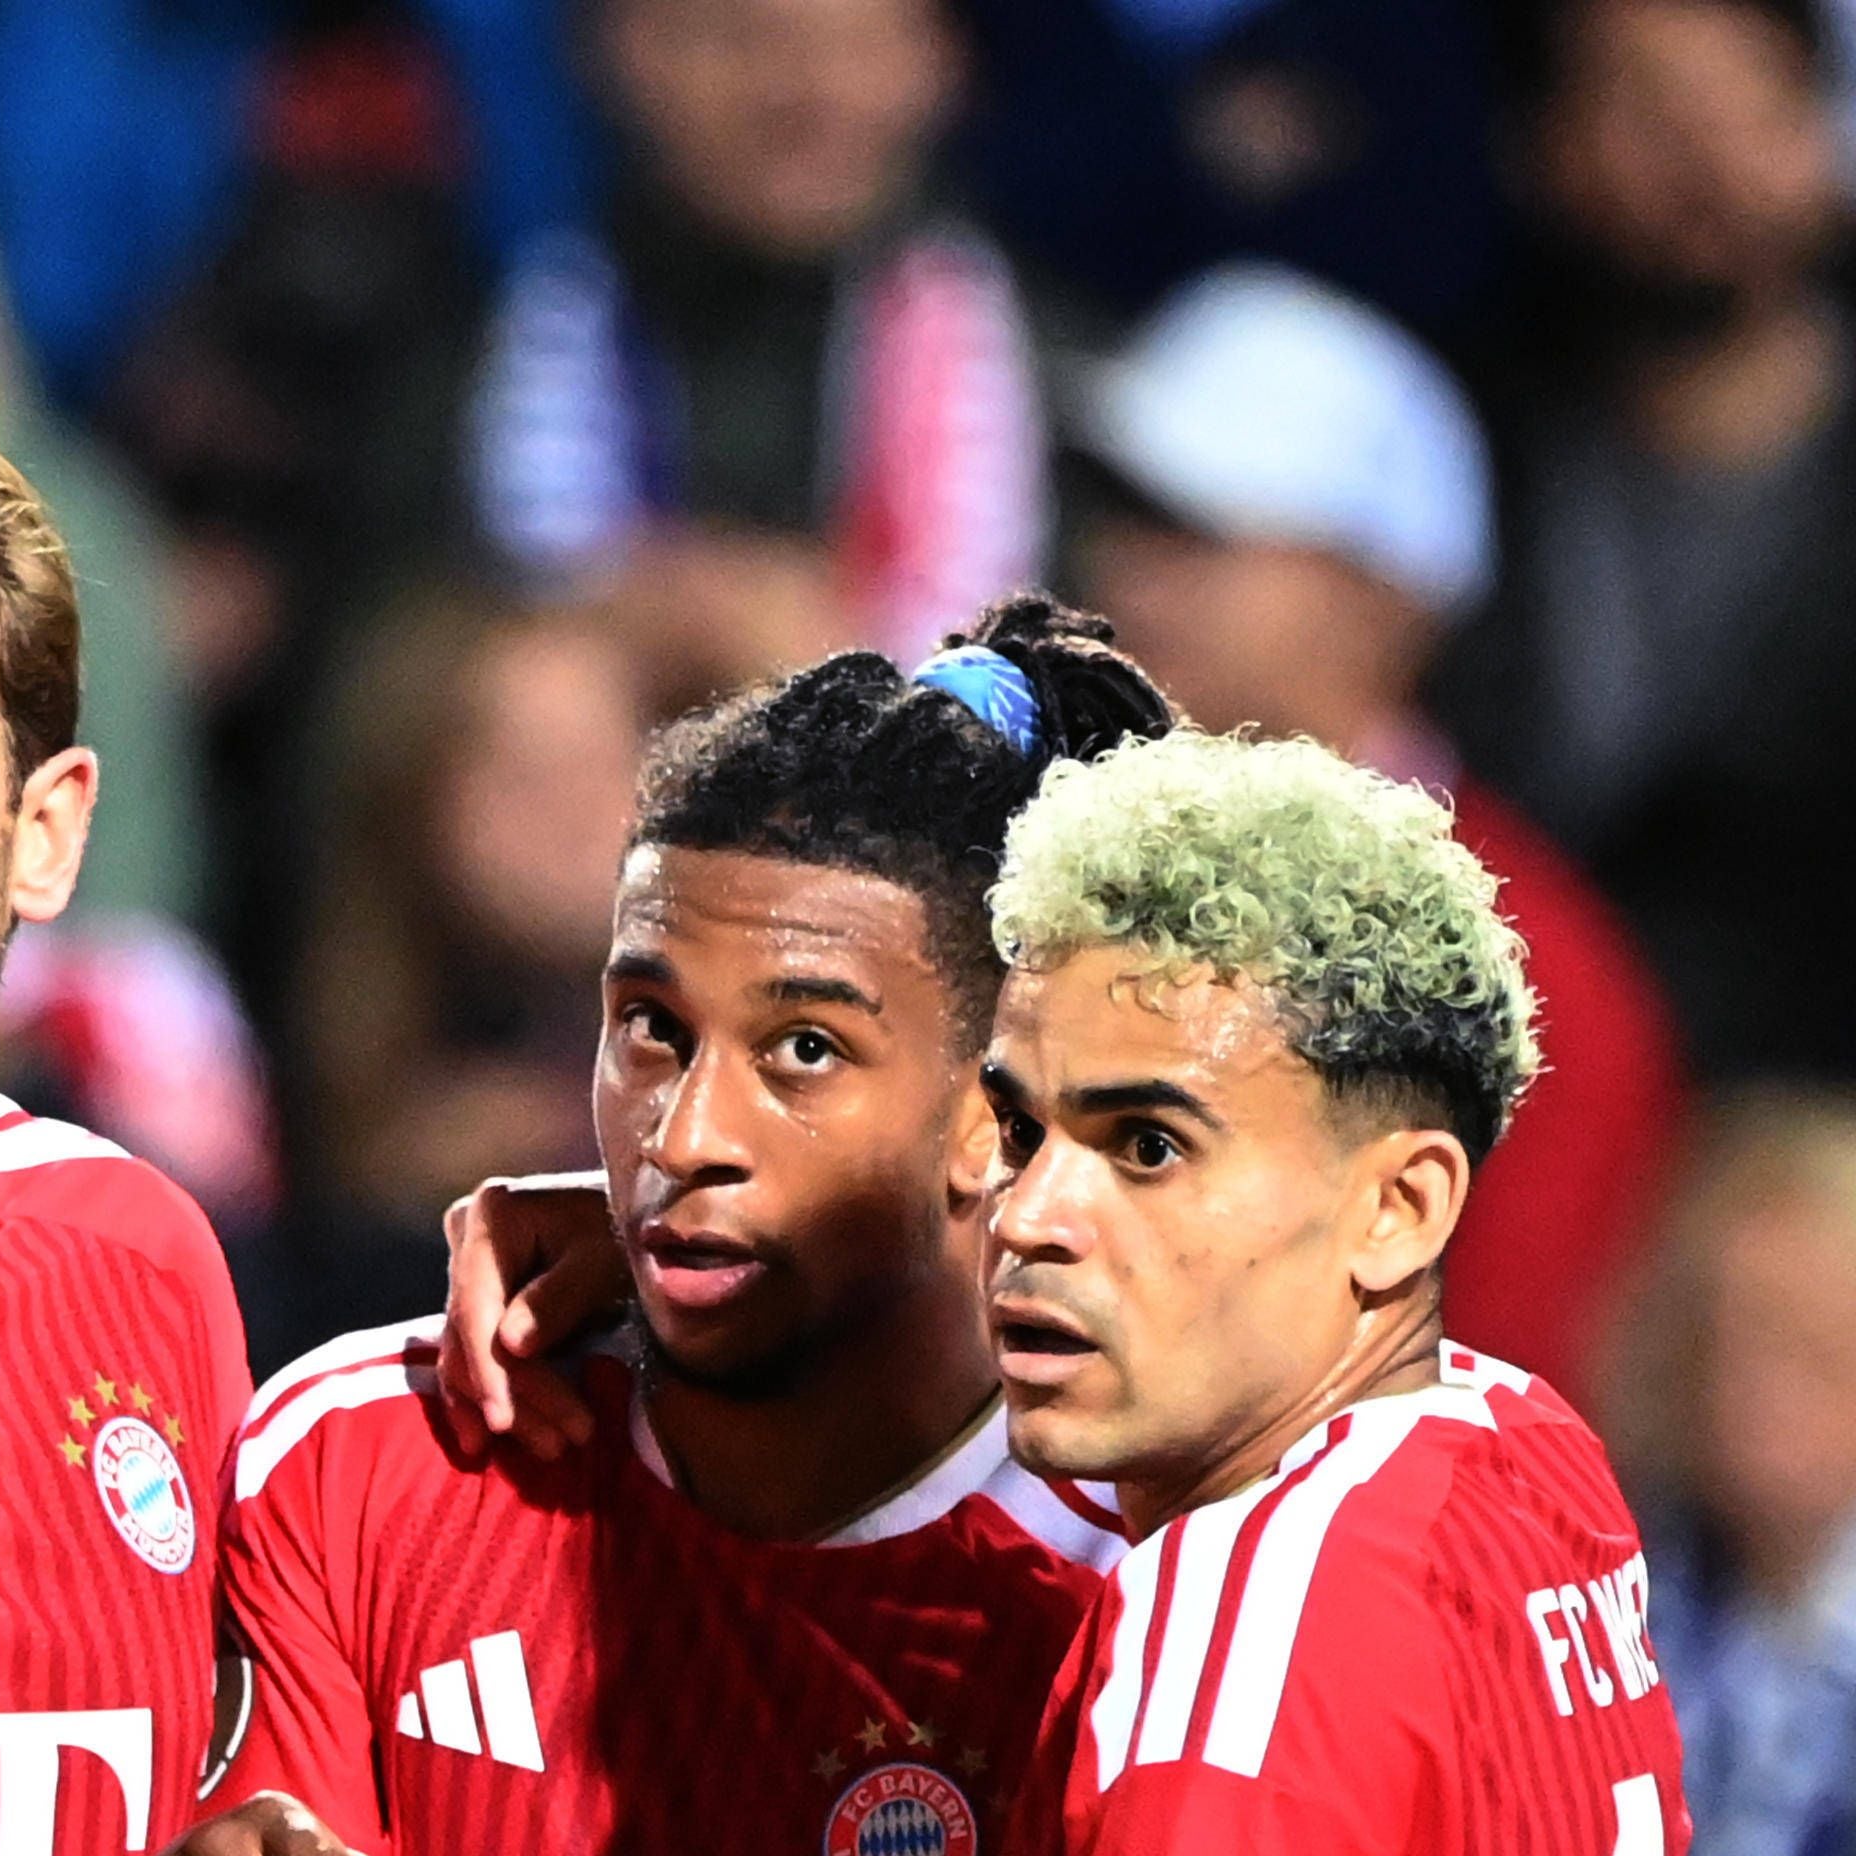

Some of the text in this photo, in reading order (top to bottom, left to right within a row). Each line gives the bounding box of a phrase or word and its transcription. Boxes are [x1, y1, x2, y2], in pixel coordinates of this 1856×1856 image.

[1525, 1582, 1615, 1718] FC
[841, 1770, 969, 1841] FC BAYERN
